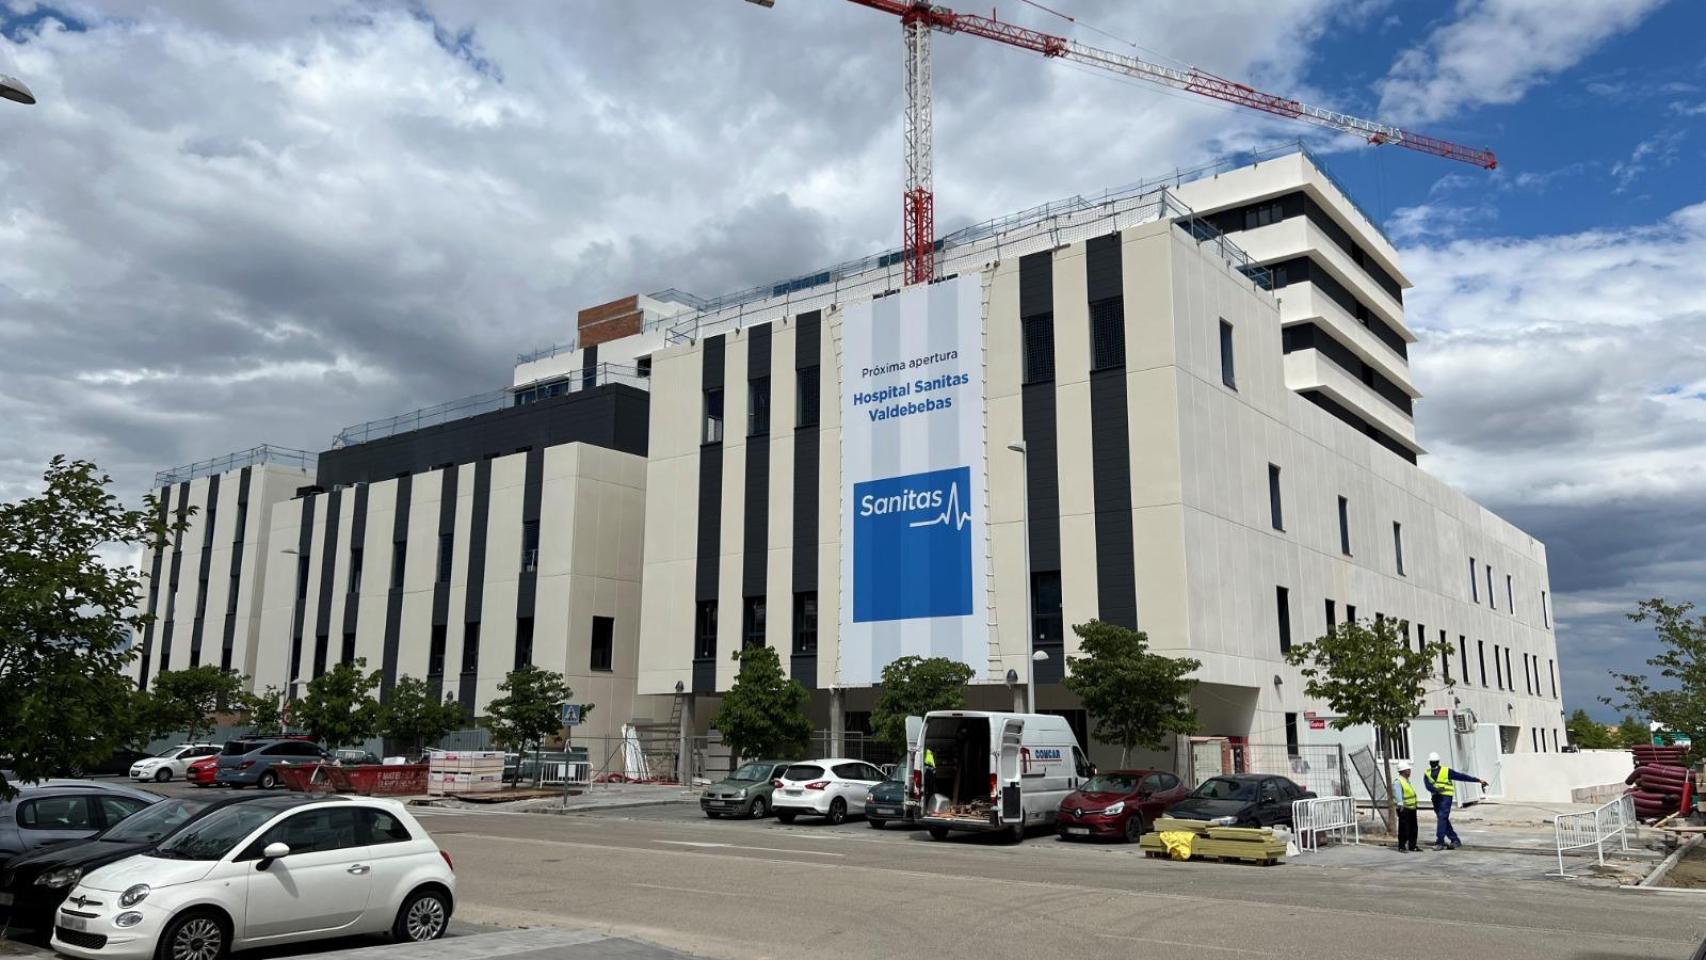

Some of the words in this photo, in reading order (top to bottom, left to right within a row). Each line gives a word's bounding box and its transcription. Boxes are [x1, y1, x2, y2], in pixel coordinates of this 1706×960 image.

[862, 361, 906, 378] Próxima
[908, 350, 958, 369] apertura
[853, 382, 910, 406] Hospital
[914, 373, 969, 393] Sanitas
[868, 397, 952, 422] Valdebebas
[860, 489, 942, 516] Sanitas
